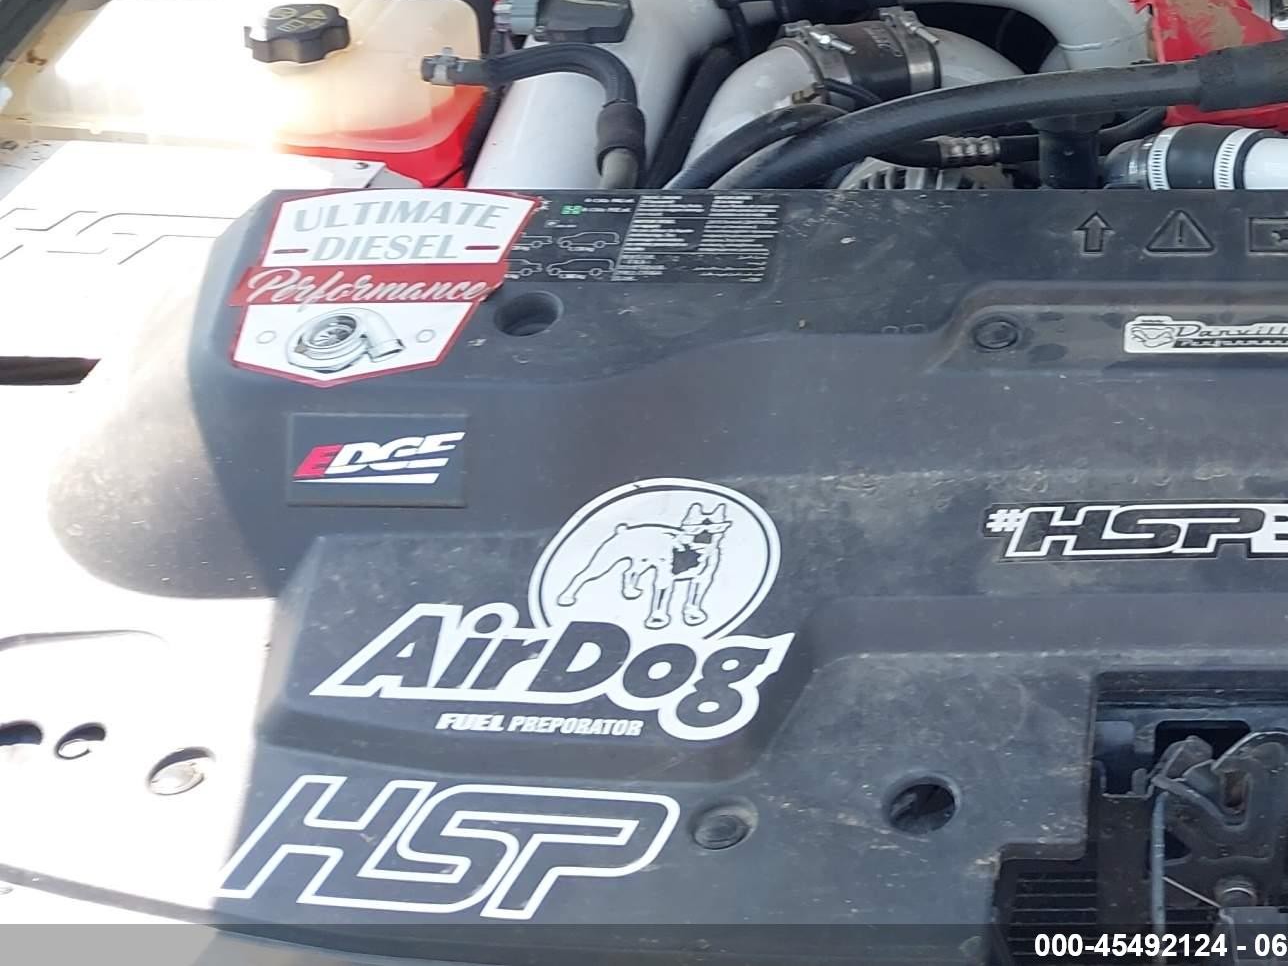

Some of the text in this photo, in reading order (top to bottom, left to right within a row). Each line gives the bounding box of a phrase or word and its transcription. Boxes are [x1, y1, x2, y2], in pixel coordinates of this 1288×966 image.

[294, 200, 510, 233] ULTIMATE
[312, 234, 458, 262] DIESEL
[246, 267, 488, 311] Performance
[293, 431, 466, 478] EDGE
[310, 603, 796, 741] AirDog
[435, 713, 645, 737] FUEL PREPORATOR
[214, 774, 682, 921] HSP
